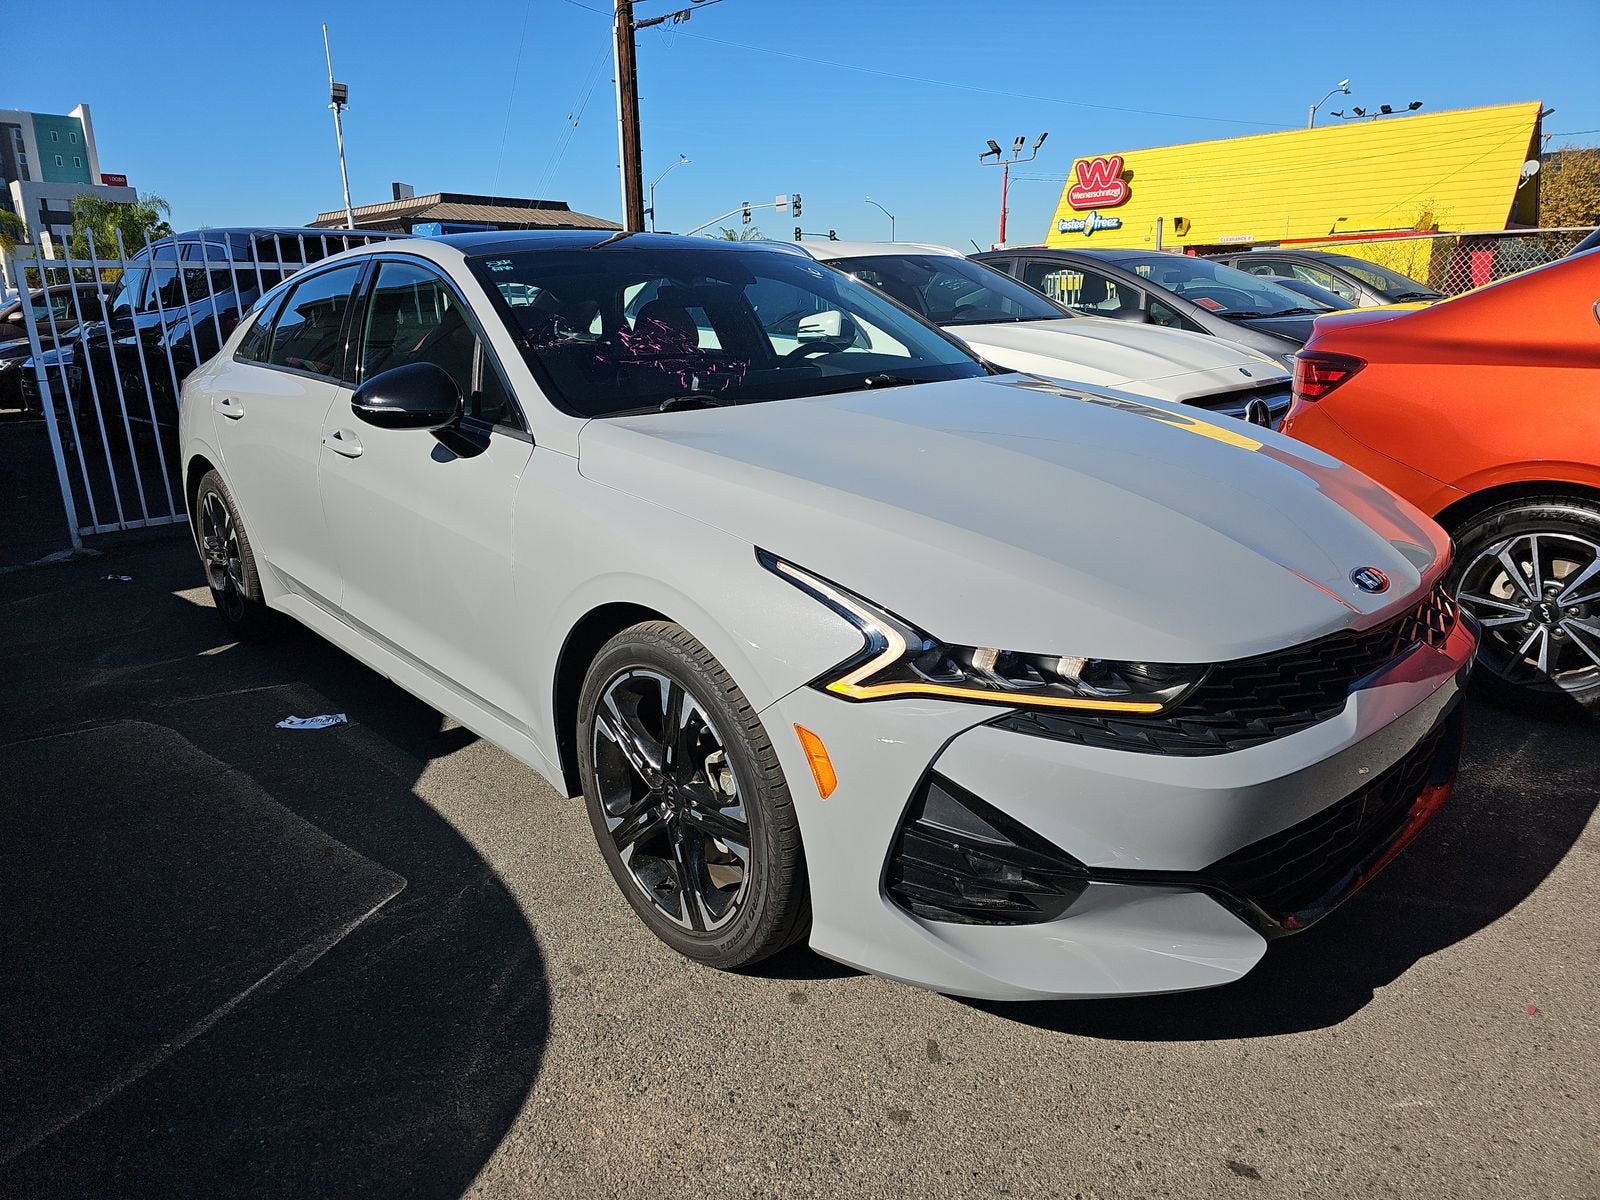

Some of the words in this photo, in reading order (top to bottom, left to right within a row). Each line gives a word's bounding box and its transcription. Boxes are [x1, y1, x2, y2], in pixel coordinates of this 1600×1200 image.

[1077, 157, 1120, 190] W
[1071, 187, 1121, 200] Wienerschnitzel
[1058, 219, 1085, 231] tastee
[1094, 216, 1120, 230] freez
[667, 785, 676, 809] KIA
